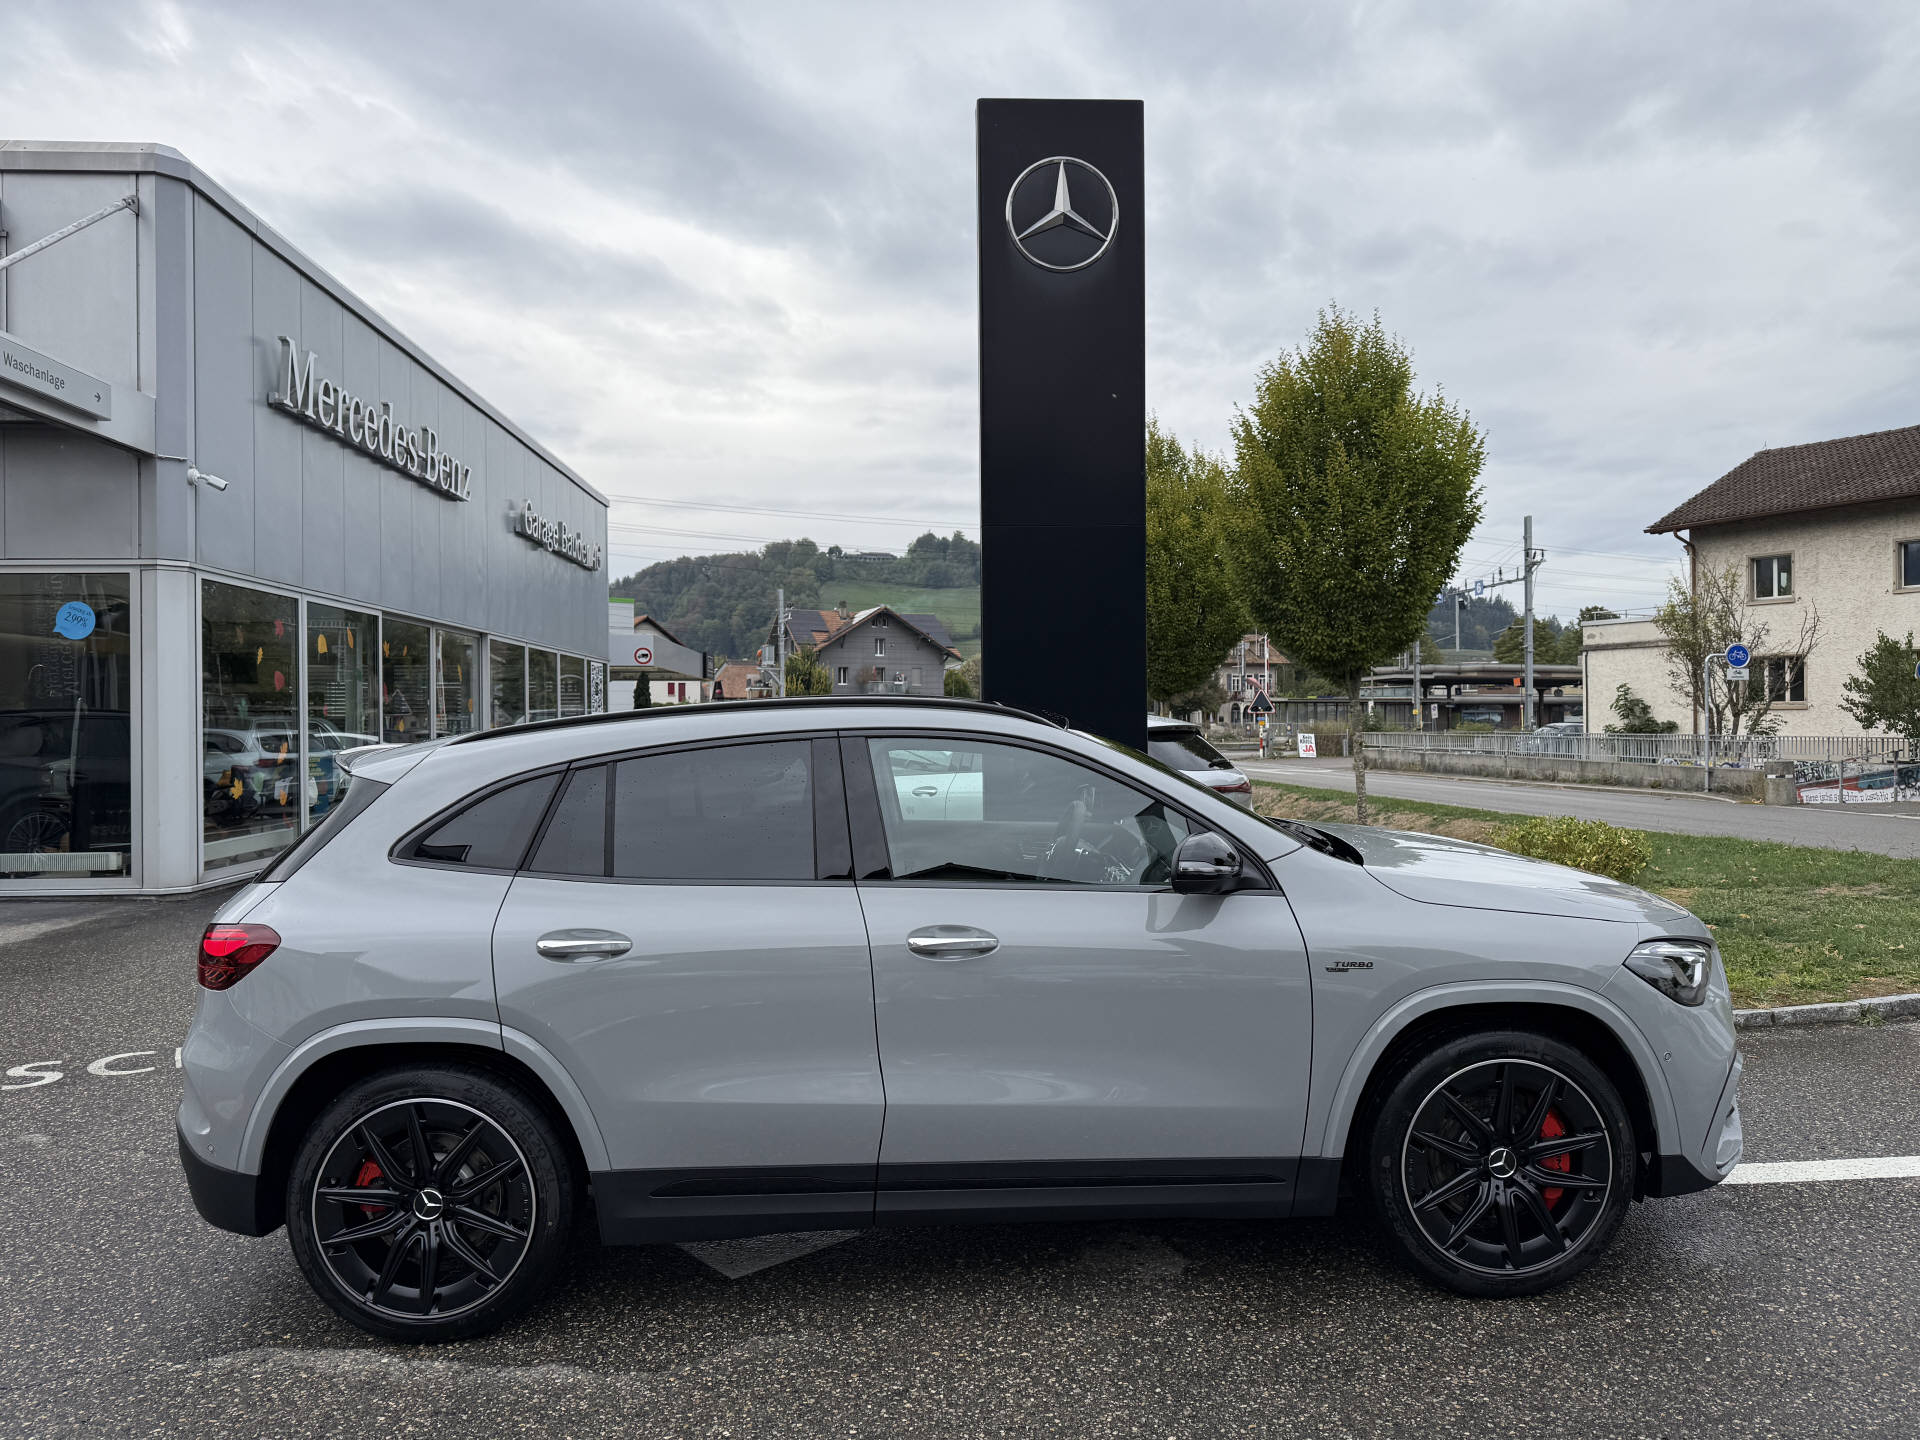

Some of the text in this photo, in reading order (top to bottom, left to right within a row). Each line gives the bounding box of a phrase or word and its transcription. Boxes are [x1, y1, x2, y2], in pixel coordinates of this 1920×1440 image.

[3, 351, 65, 390] Waschanlage
[278, 336, 473, 502] Mercedes-Benz
[525, 499, 559, 551] Garage
[1303, 744, 1315, 752] JA
[0, 1047, 182, 1090] SC
